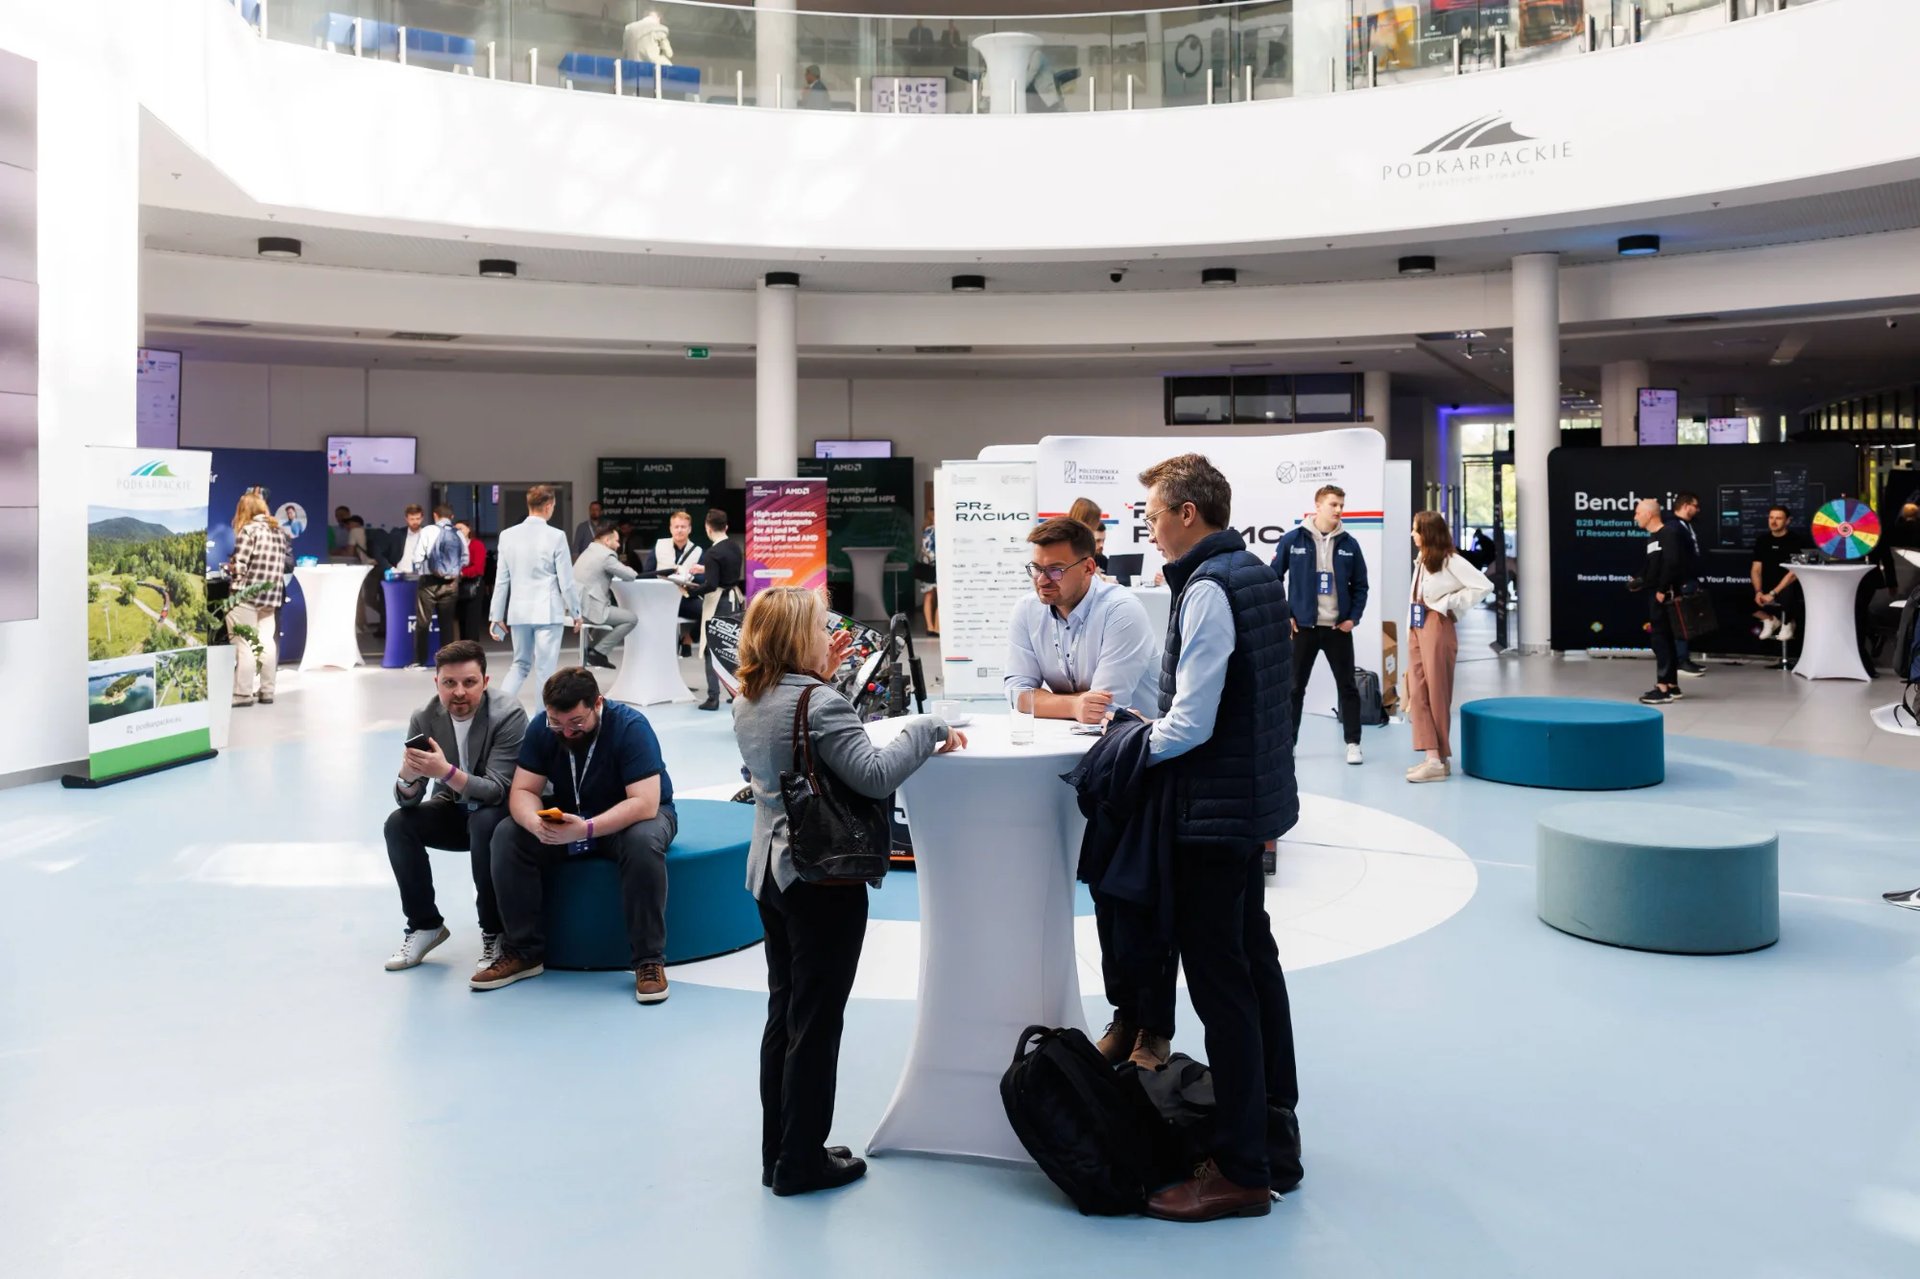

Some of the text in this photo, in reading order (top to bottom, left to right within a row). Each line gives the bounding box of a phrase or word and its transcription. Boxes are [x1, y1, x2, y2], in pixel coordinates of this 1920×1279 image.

[1382, 141, 1573, 181] PODKARPACKIE
[643, 464, 664, 472] AMD
[116, 478, 191, 490] PODKARPACKIE
[603, 487, 709, 497] Power next-gen workloads
[827, 487, 877, 495] percomputer
[669, 498, 706, 506] empower
[603, 508, 621, 516] your
[1576, 519, 1632, 527] B2B Platform
